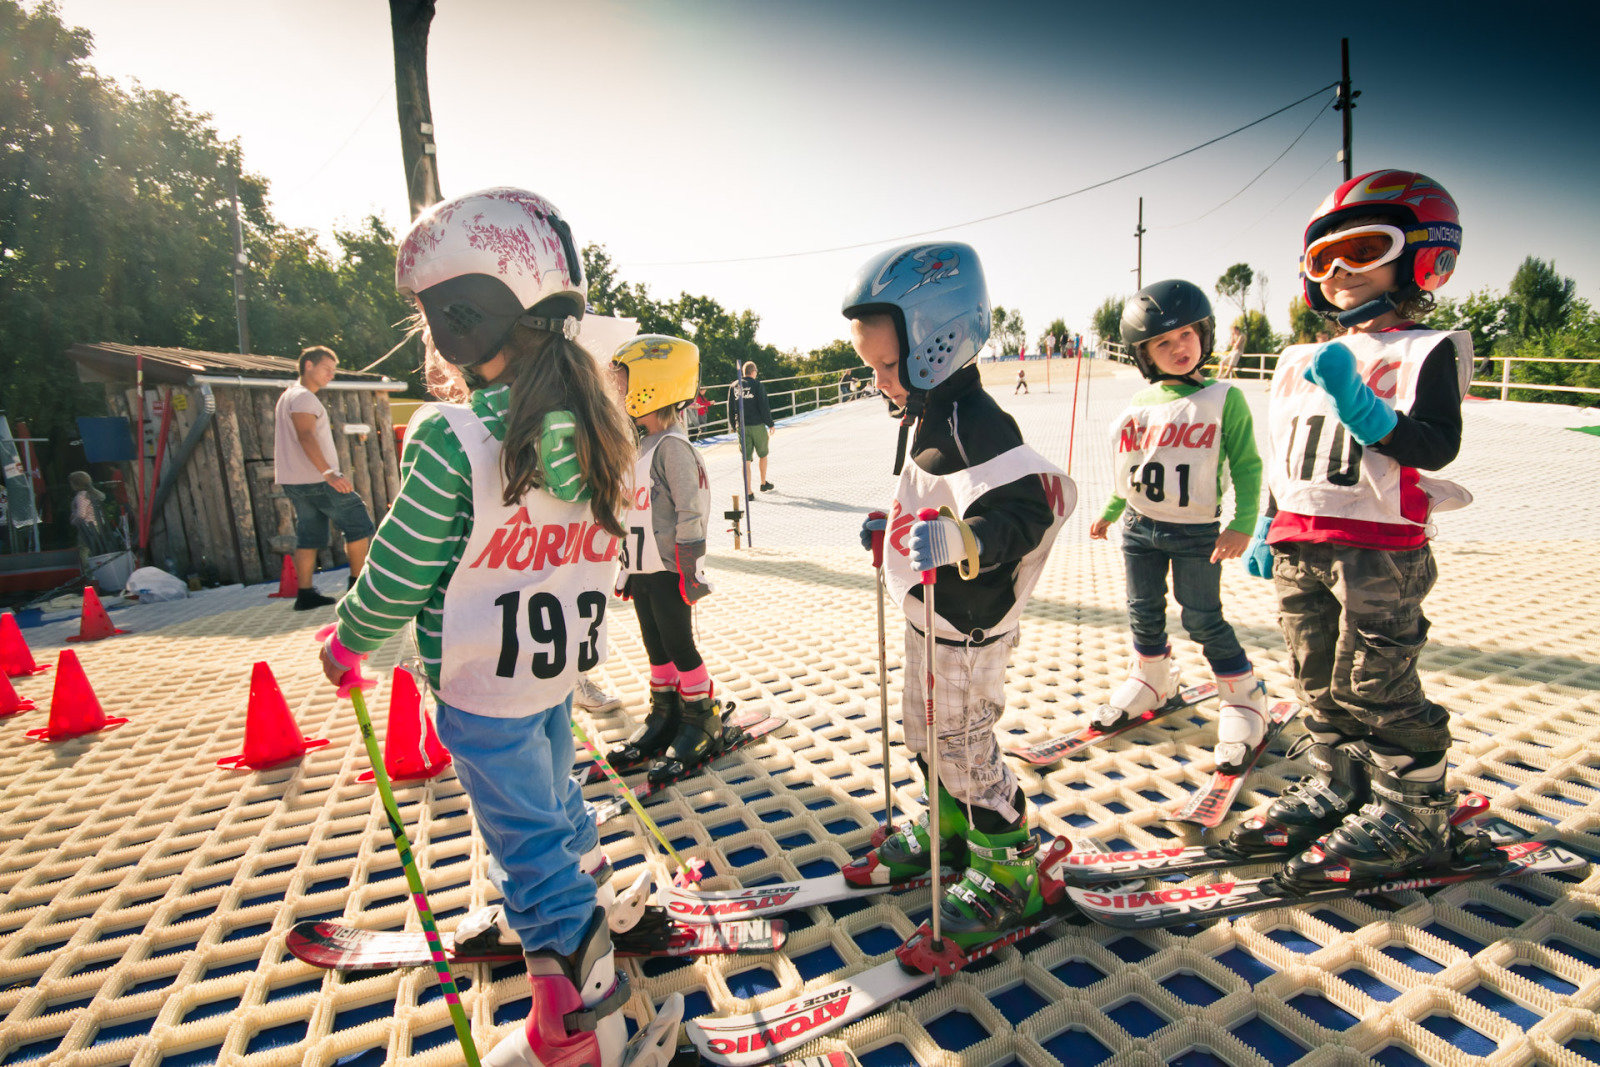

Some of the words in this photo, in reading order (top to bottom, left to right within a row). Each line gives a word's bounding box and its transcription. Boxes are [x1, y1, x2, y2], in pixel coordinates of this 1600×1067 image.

[494, 591, 607, 680] 193
[668, 892, 796, 916] ATOMIC
[1084, 882, 1236, 909] ATOMIC
[803, 985, 853, 1008] RACE
[707, 994, 851, 1055] ATOMIC
